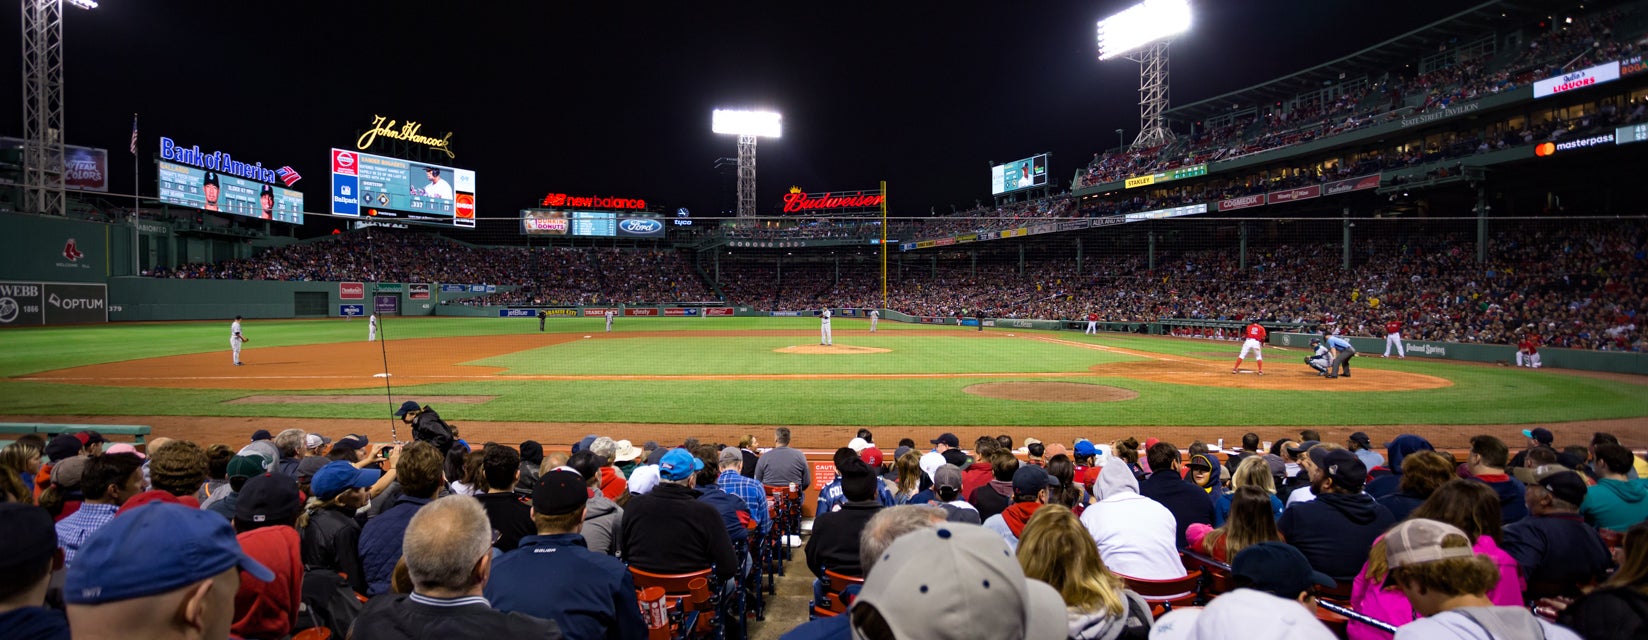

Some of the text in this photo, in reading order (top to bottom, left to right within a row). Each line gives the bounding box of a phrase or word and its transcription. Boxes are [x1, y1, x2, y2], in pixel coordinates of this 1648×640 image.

[1553, 77, 1595, 93] LIQUORS
[1401, 103, 1479, 127] STATE STREET PAVILION
[357, 114, 455, 159] John Hancock
[1556, 134, 1614, 150] masterpass
[160, 136, 205, 167] Bank
[204, 151, 222, 170] of
[222, 153, 276, 184] America
[334, 196, 358, 204] Ballpark
[567, 196, 593, 207] new
[594, 194, 645, 209] balance
[783, 192, 885, 212] Budweiser
[628, 220, 653, 231] Ford
[0, 285, 38, 297] WEBB
[62, 299, 104, 309] OPTUM
[507, 309, 528, 317] jetBlue
[1406, 343, 1445, 356] Poland Spring
